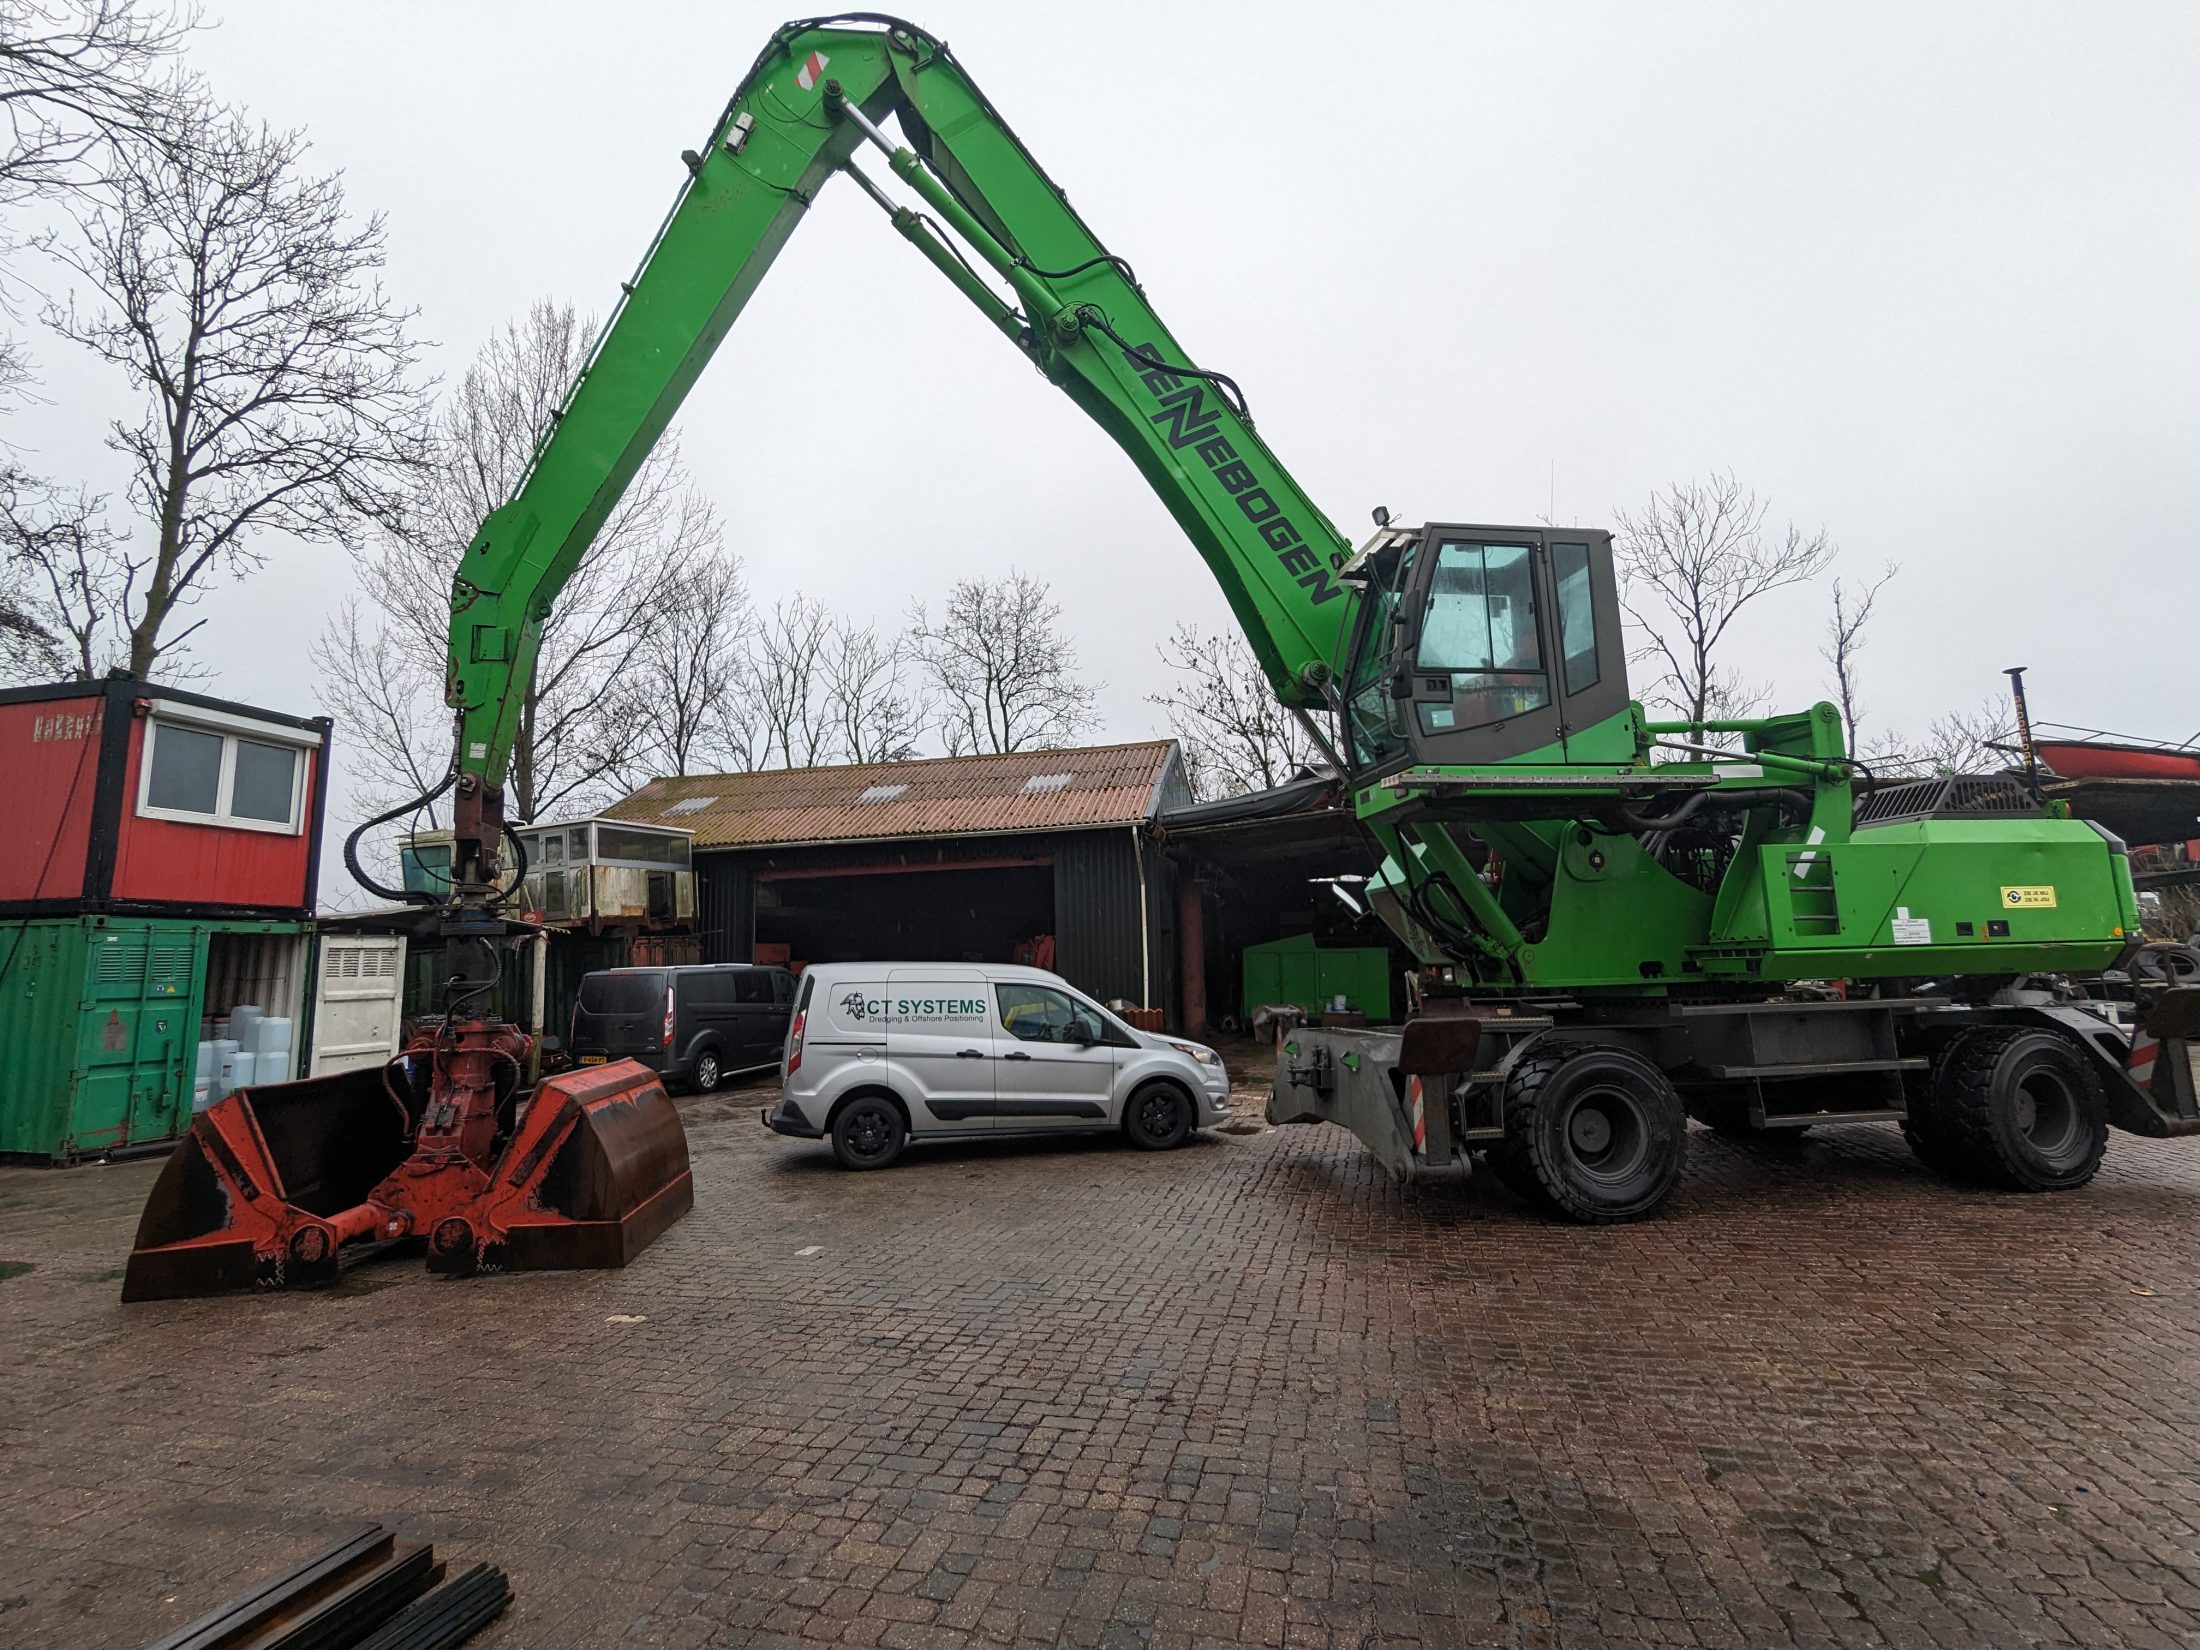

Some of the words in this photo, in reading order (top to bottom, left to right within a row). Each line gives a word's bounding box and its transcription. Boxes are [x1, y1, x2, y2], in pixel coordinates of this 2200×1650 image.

[1122, 342, 1344, 606] SENNEBOGEN
[867, 1000, 893, 1015] CT
[898, 999, 986, 1015] SYSTEMS
[869, 1015, 903, 1024] Dredging
[944, 1015, 984, 1023] Positioning
